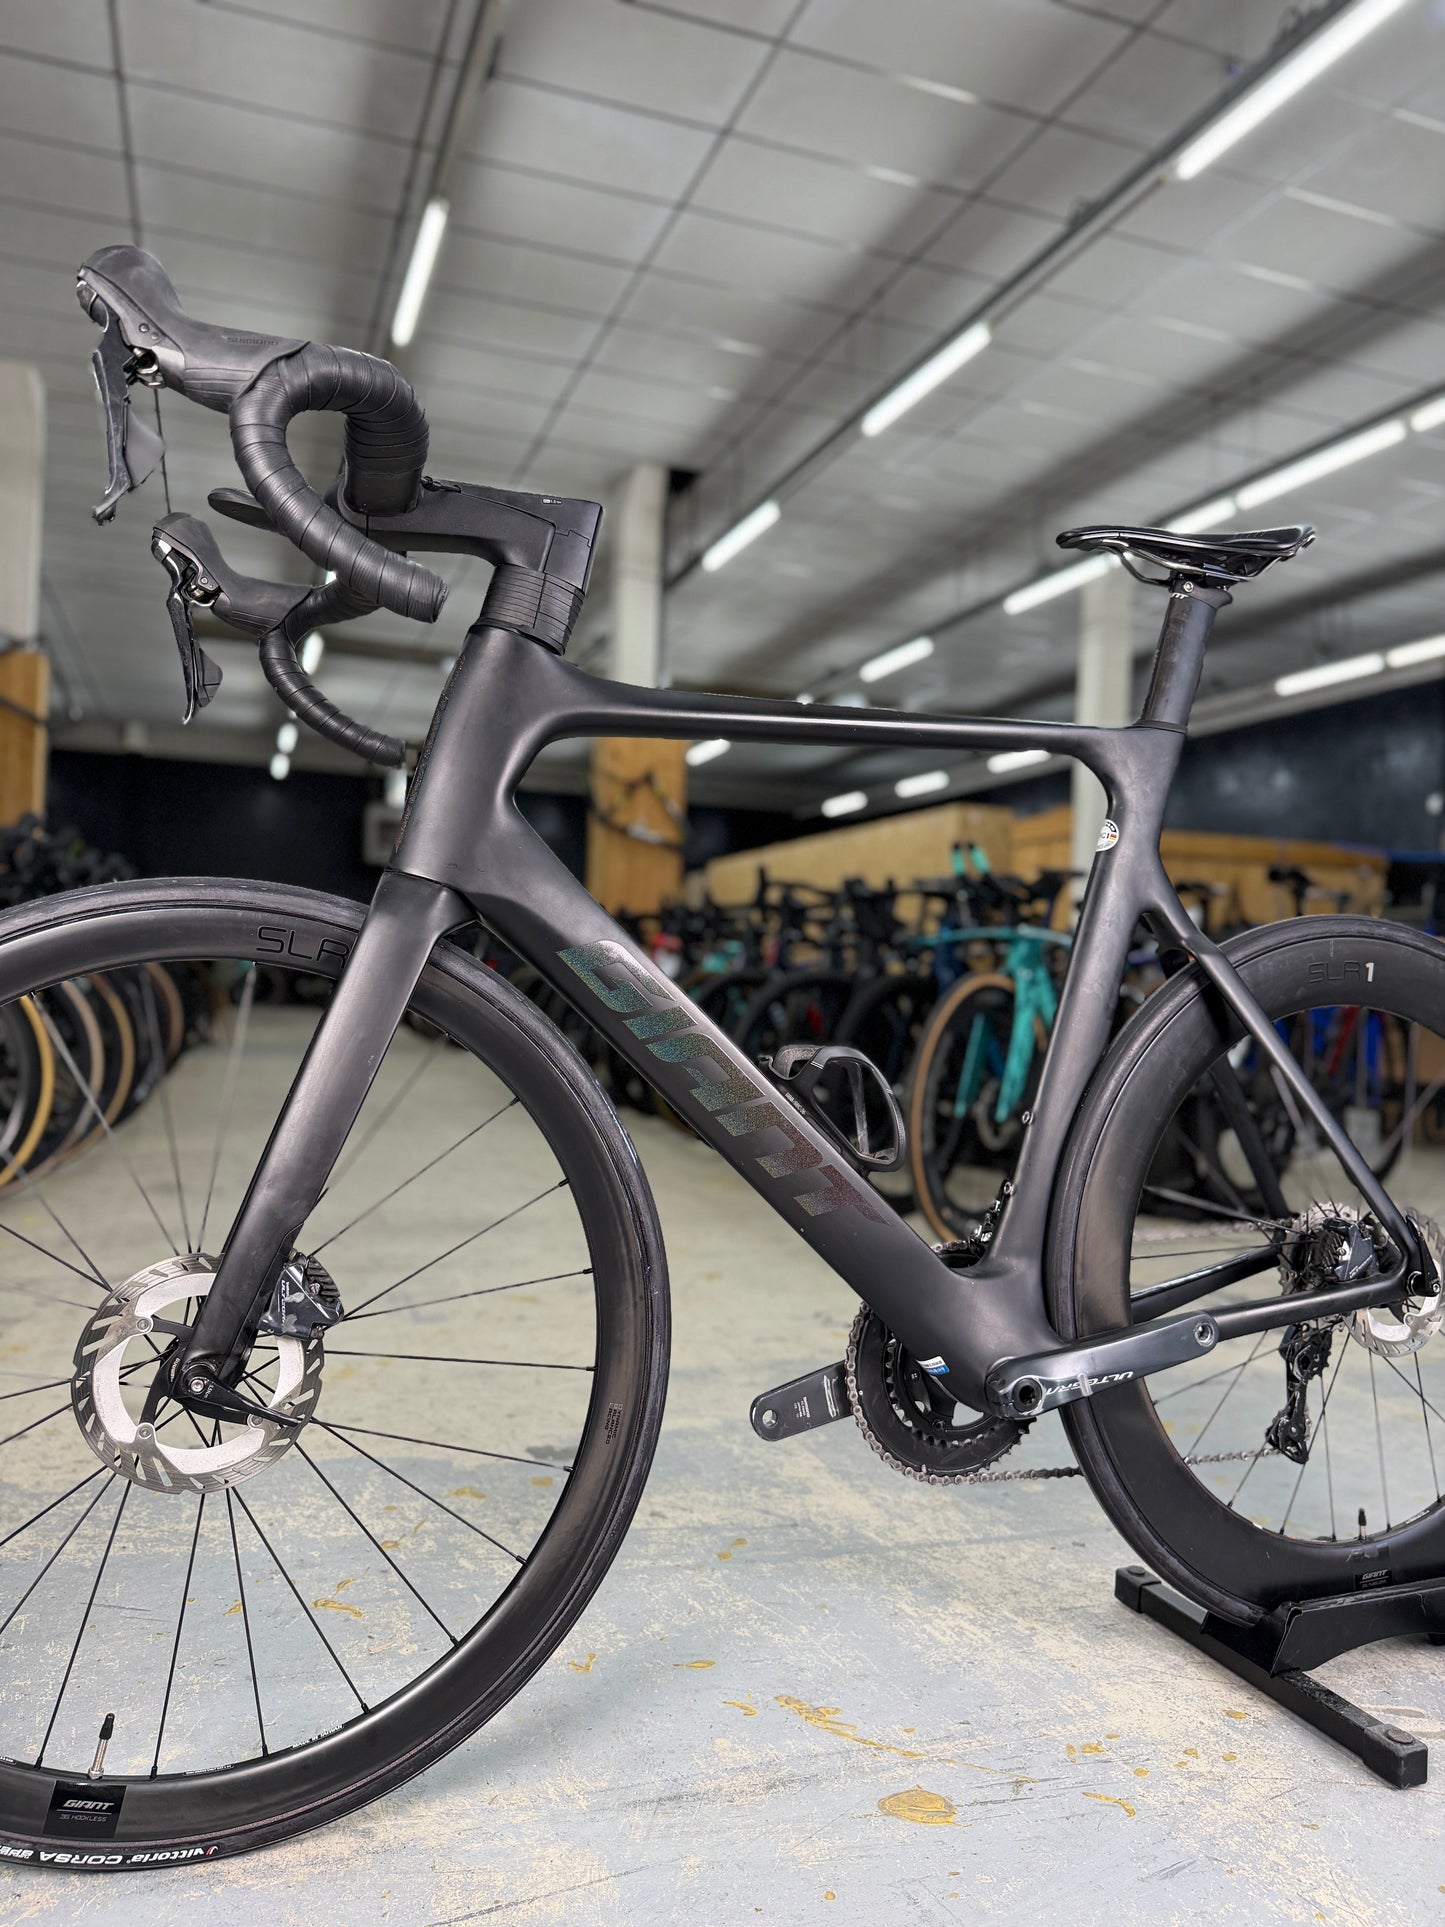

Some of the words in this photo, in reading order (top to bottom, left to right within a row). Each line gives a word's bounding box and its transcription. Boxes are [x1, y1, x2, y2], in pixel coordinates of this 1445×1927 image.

[256, 926, 350, 969] SLR
[1308, 961, 1361, 983] SLR
[1365, 962, 1375, 983] 1
[555, 939, 892, 1227] GIANT
[62, 1799, 115, 1810] GIANT
[0, 1845, 34, 1859] SPE
[40, 1851, 123, 1864] CORSA
